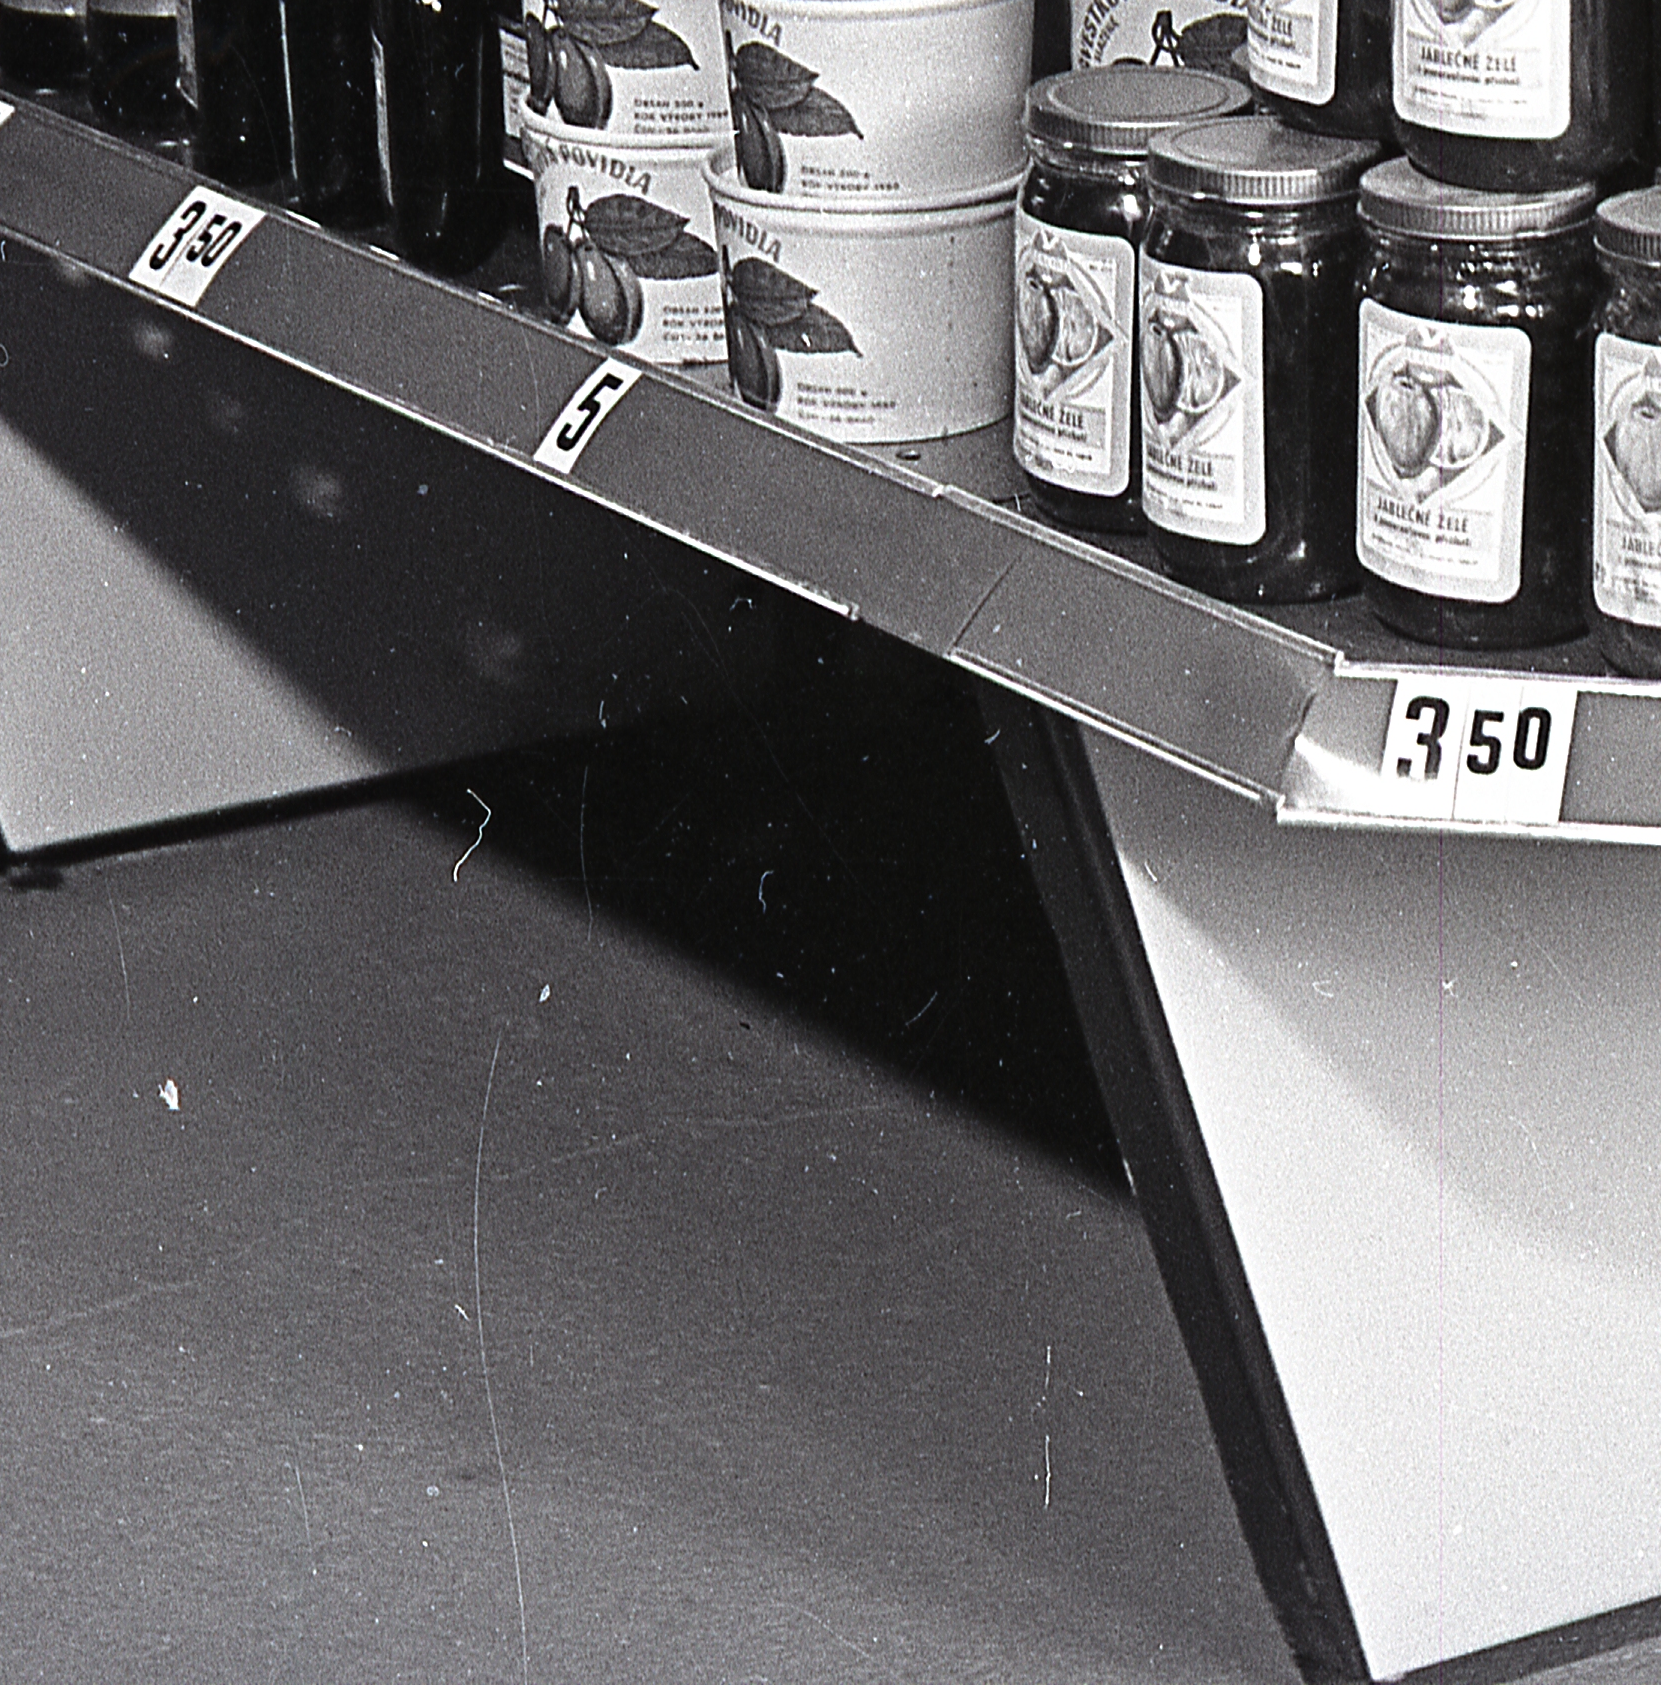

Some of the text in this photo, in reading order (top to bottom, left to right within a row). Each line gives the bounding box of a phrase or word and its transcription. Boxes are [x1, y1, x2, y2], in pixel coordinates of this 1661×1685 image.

[1420, 45, 1518, 73] JABLEČNÉ ŽELÉ
[558, 143, 652, 195] POVIDLA
[149, 200, 243, 271] 3 50
[552, 364, 621, 452] 5
[1376, 492, 1470, 534] JABLEČNÉ ŽELÉ
[1397, 695, 1553, 780] 3 50
